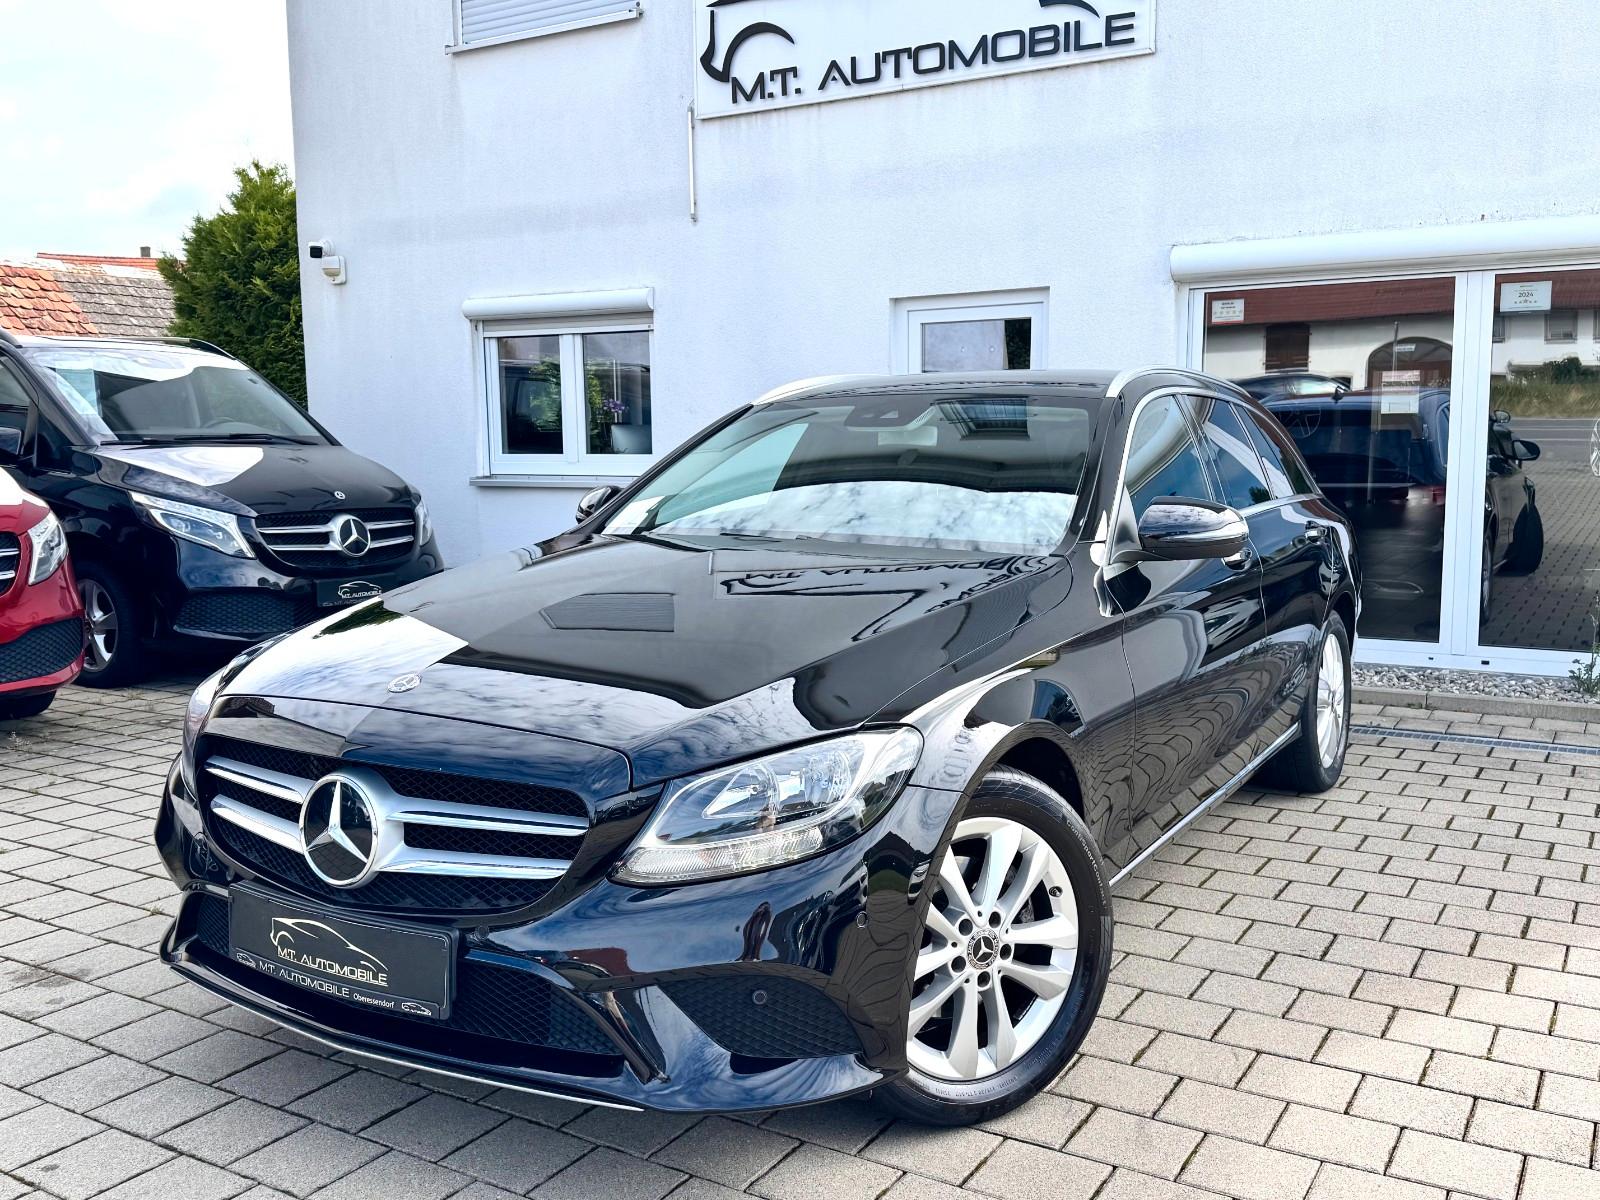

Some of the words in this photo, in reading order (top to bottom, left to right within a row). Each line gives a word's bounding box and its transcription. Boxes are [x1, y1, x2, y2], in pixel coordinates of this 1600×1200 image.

[731, 66, 802, 104] M.T.
[818, 11, 1136, 91] AUTOMOBILE
[259, 960, 277, 975] M.T.
[279, 969, 350, 998] AUTOMOBILE
[353, 992, 395, 1009] Oberessendorf
[277, 945, 297, 961] M.T.
[301, 954, 388, 986] AUTOMOBILE
